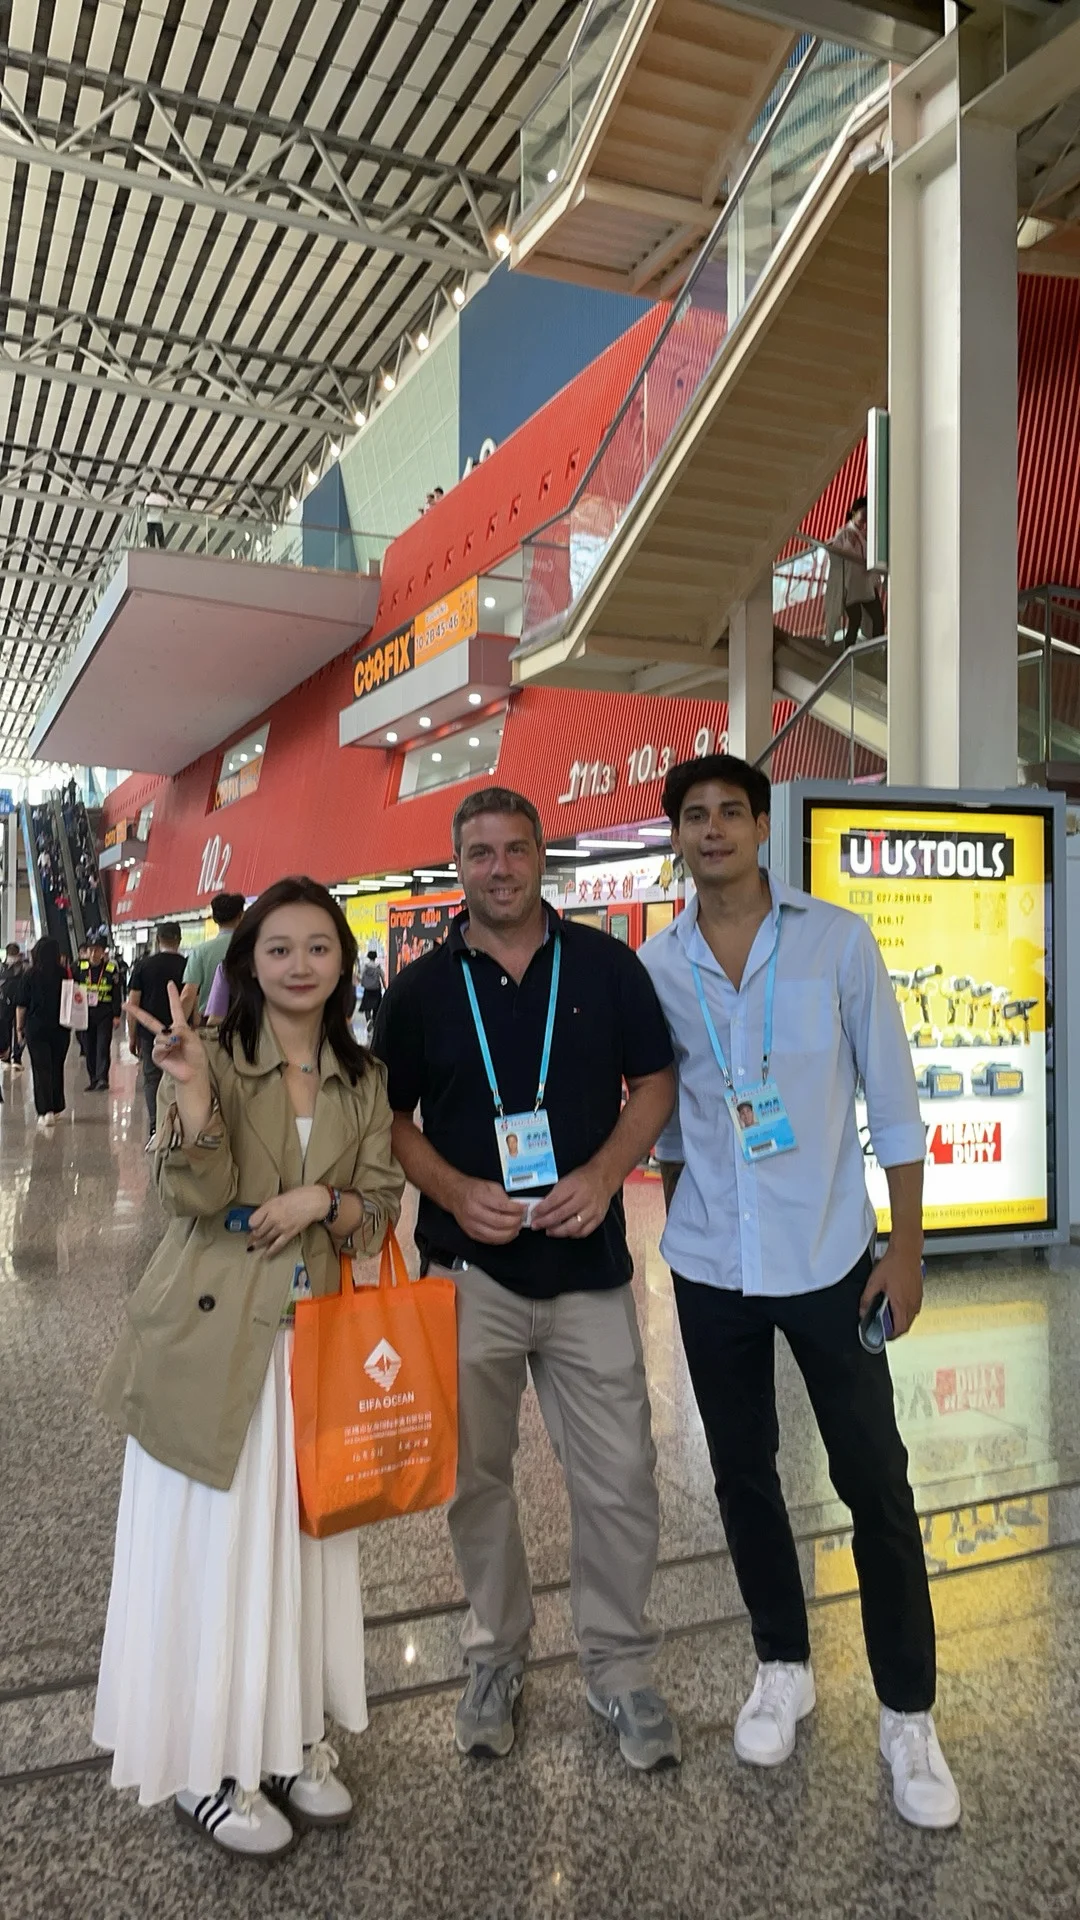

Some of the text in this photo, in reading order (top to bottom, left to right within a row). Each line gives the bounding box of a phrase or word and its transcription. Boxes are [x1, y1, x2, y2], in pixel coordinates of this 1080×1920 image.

[628, 744, 671, 787] 10.3
[197, 834, 232, 896] 10.2
[941, 1121, 997, 1144] HEAVY
[952, 1142, 997, 1164] DUTY
[359, 1391, 415, 1413] EIFA OCEAN
